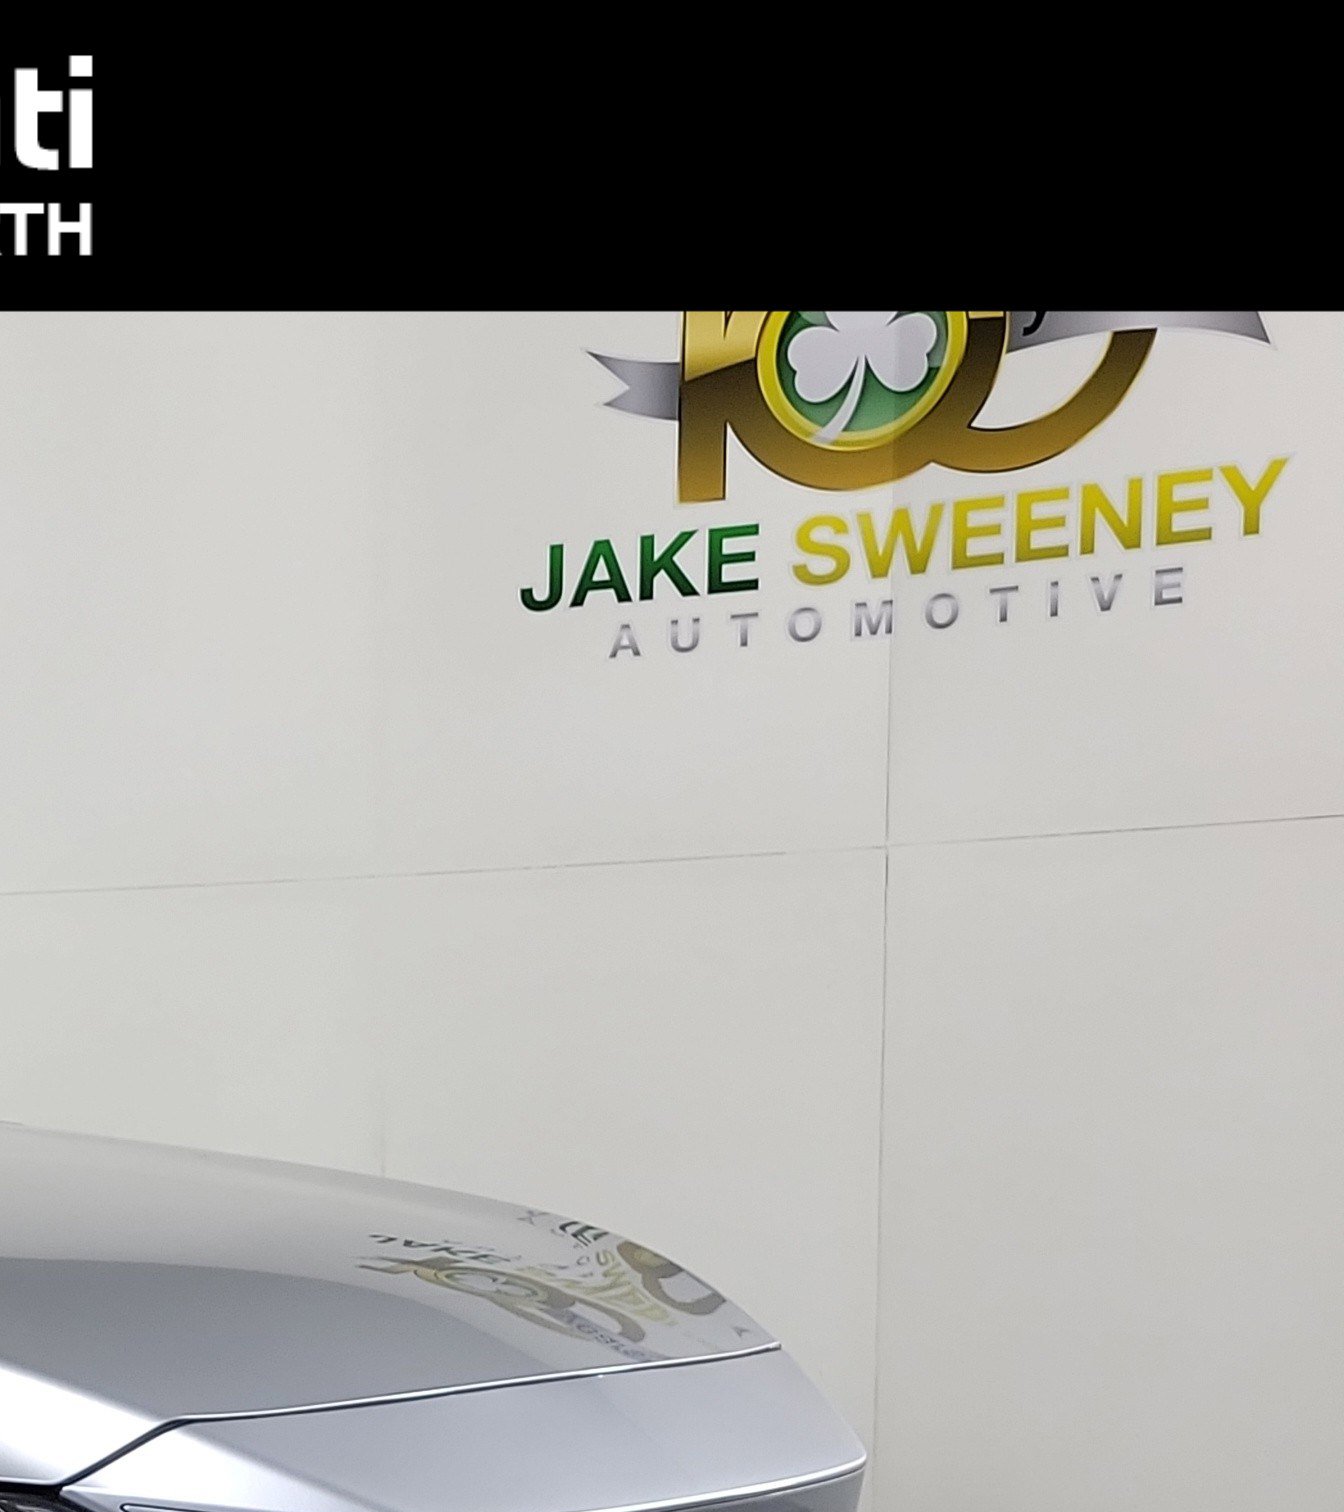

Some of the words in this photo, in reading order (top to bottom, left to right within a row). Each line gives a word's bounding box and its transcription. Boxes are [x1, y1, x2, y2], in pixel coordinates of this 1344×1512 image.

[519, 522, 761, 614] JAKE
[791, 456, 1290, 587] SWEENEY
[608, 566, 1186, 660] AUTOMOTIVE
